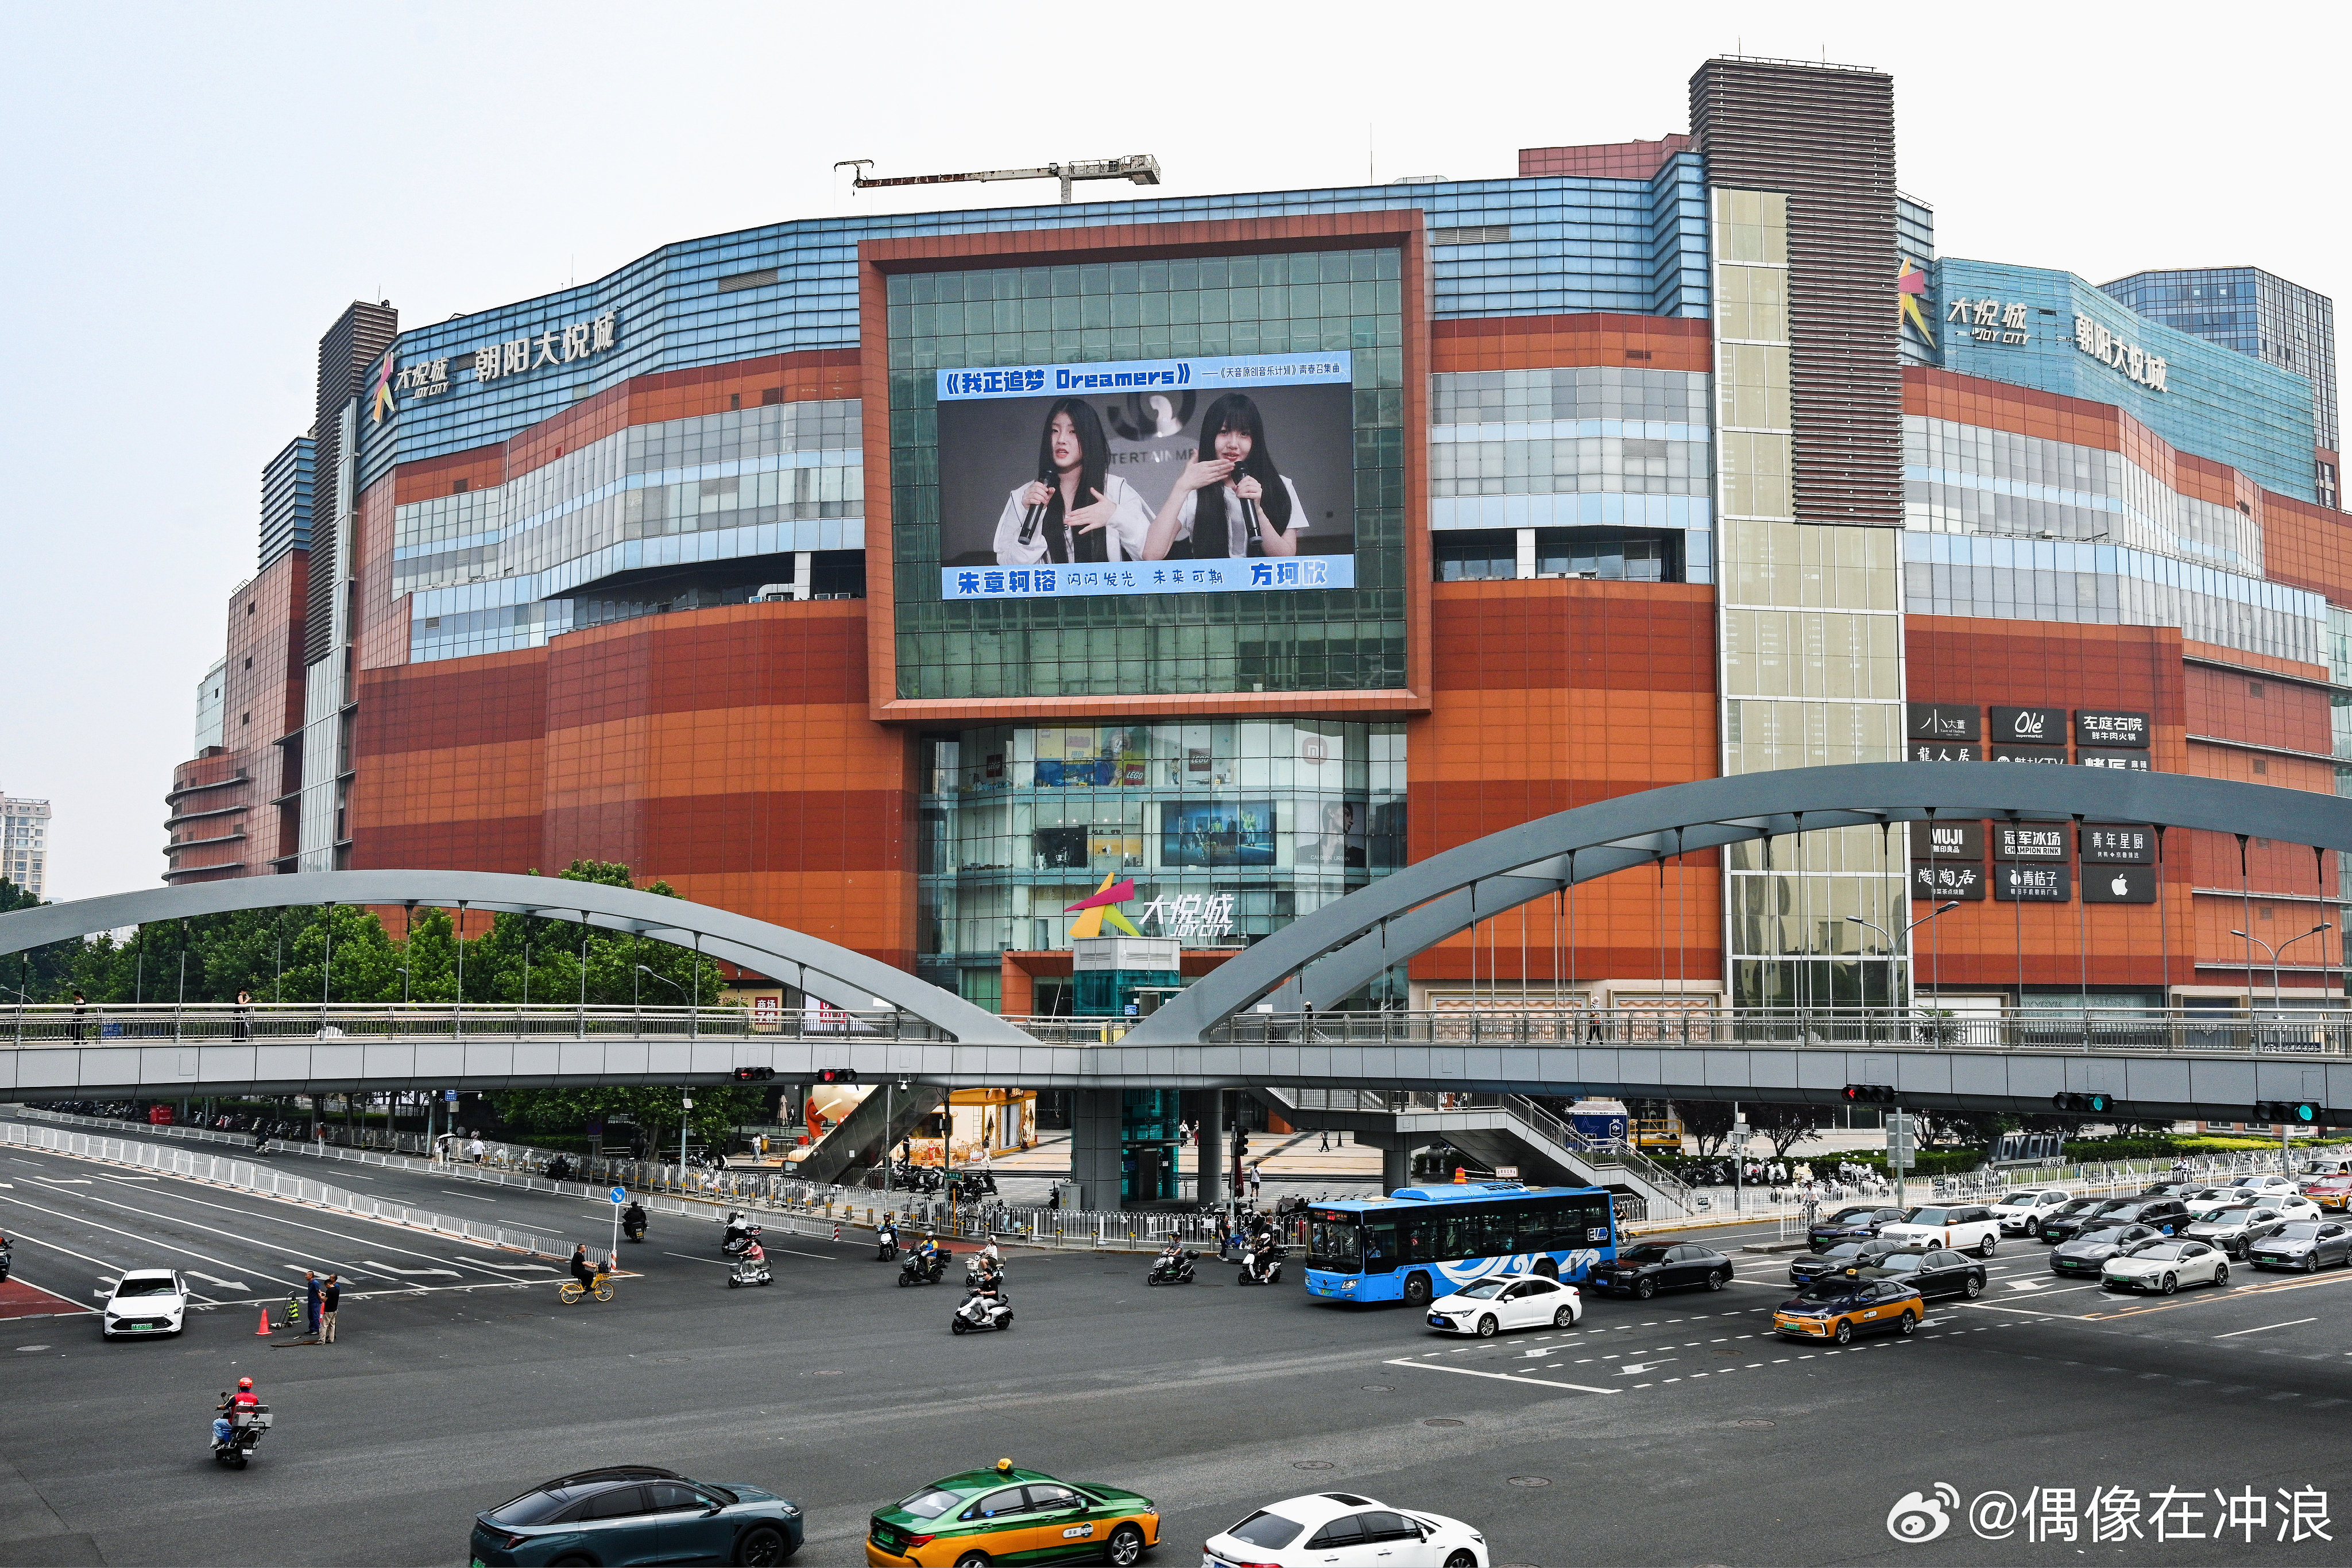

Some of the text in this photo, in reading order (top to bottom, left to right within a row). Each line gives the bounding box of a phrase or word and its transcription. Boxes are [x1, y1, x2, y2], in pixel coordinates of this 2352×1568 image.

[1947, 297, 2028, 330] 大悦城
[1976, 328, 2030, 345] JOY CITY
[474, 311, 615, 383] 朝阳大悦城
[2075, 312, 2168, 393] 朝阳大悦城
[394, 357, 450, 392] 大悦城
[412, 381, 450, 400] JOY CITY
[1067, 571, 1136, 587] 闪闪发光
[1153, 568, 1224, 585] 未来可期
[2083, 715, 2143, 731] 左庭右院
[2092, 731, 2136, 741] 鲜牛肉火锅
[1190, 754, 1209, 765] LEGO
[1125, 771, 1144, 780] LEGO
[1929, 828, 1963, 845] MUJI
[2004, 830, 2061, 846] 冠军冰场
[2092, 831, 2144, 849] 青年星厨
[1932, 845, 1960, 853] 無印良品
[1918, 868, 1976, 888] 陶陶居
[2023, 871, 2057, 886] 青桔子
[1139, 893, 1235, 924] 大悦城
[1170, 924, 1234, 937] JOY CITY
[1991, 1132, 2067, 1162] JOY CITY
